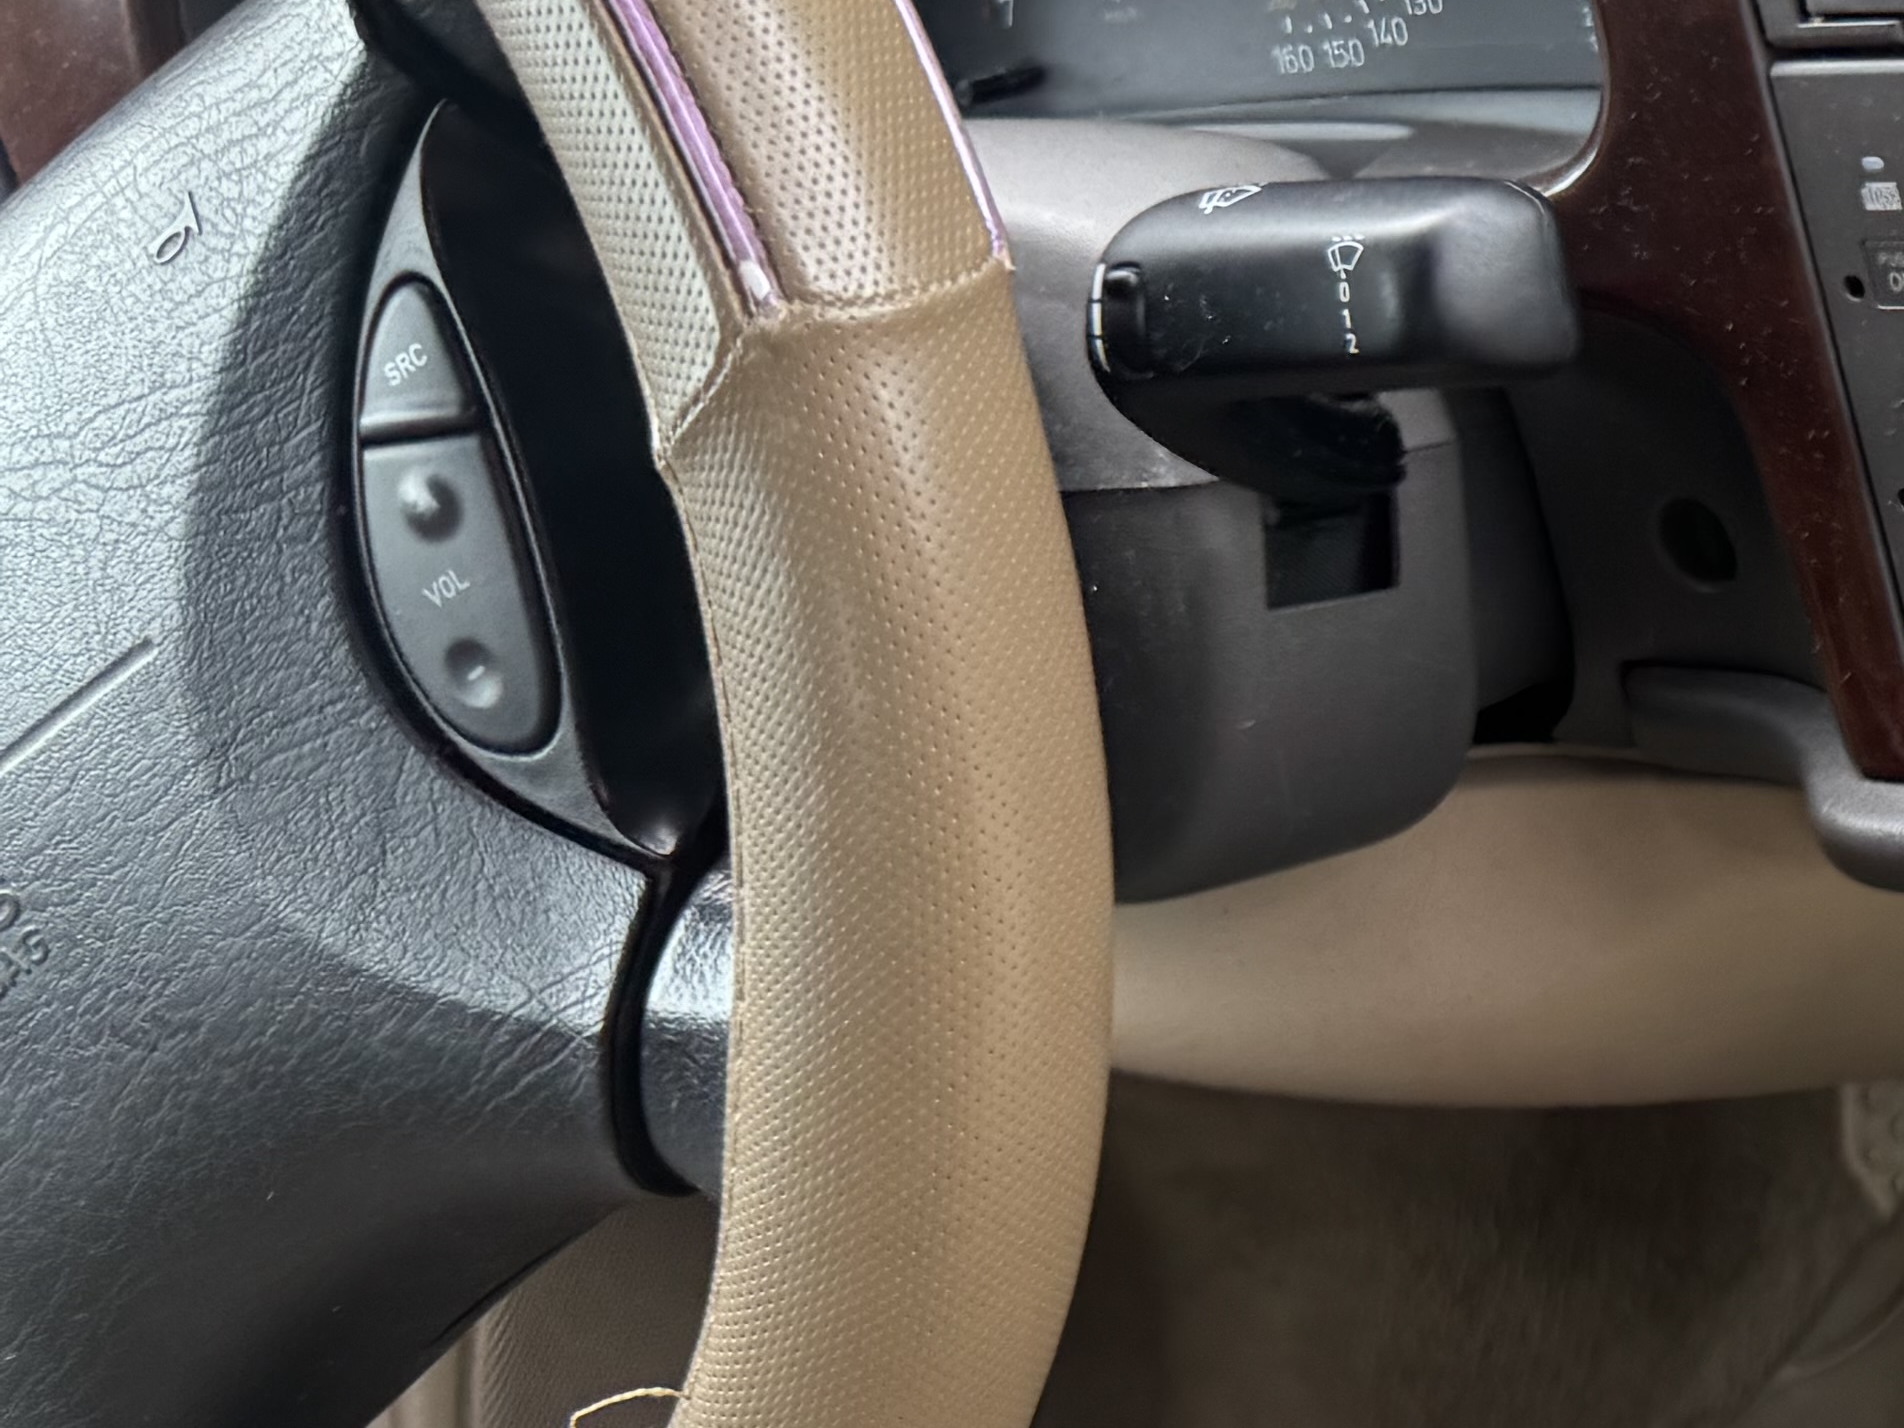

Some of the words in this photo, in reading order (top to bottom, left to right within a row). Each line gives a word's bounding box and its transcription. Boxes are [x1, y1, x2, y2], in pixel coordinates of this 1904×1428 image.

[1367, 17, 1410, 47] 140
[1270, 44, 1315, 74] 160
[1322, 38, 1366, 68] 150
[1340, 281, 1350, 303] 0
[1345, 332, 1360, 354] 2
[384, 342, 429, 387] SRC
[421, 569, 471, 610] VOL
